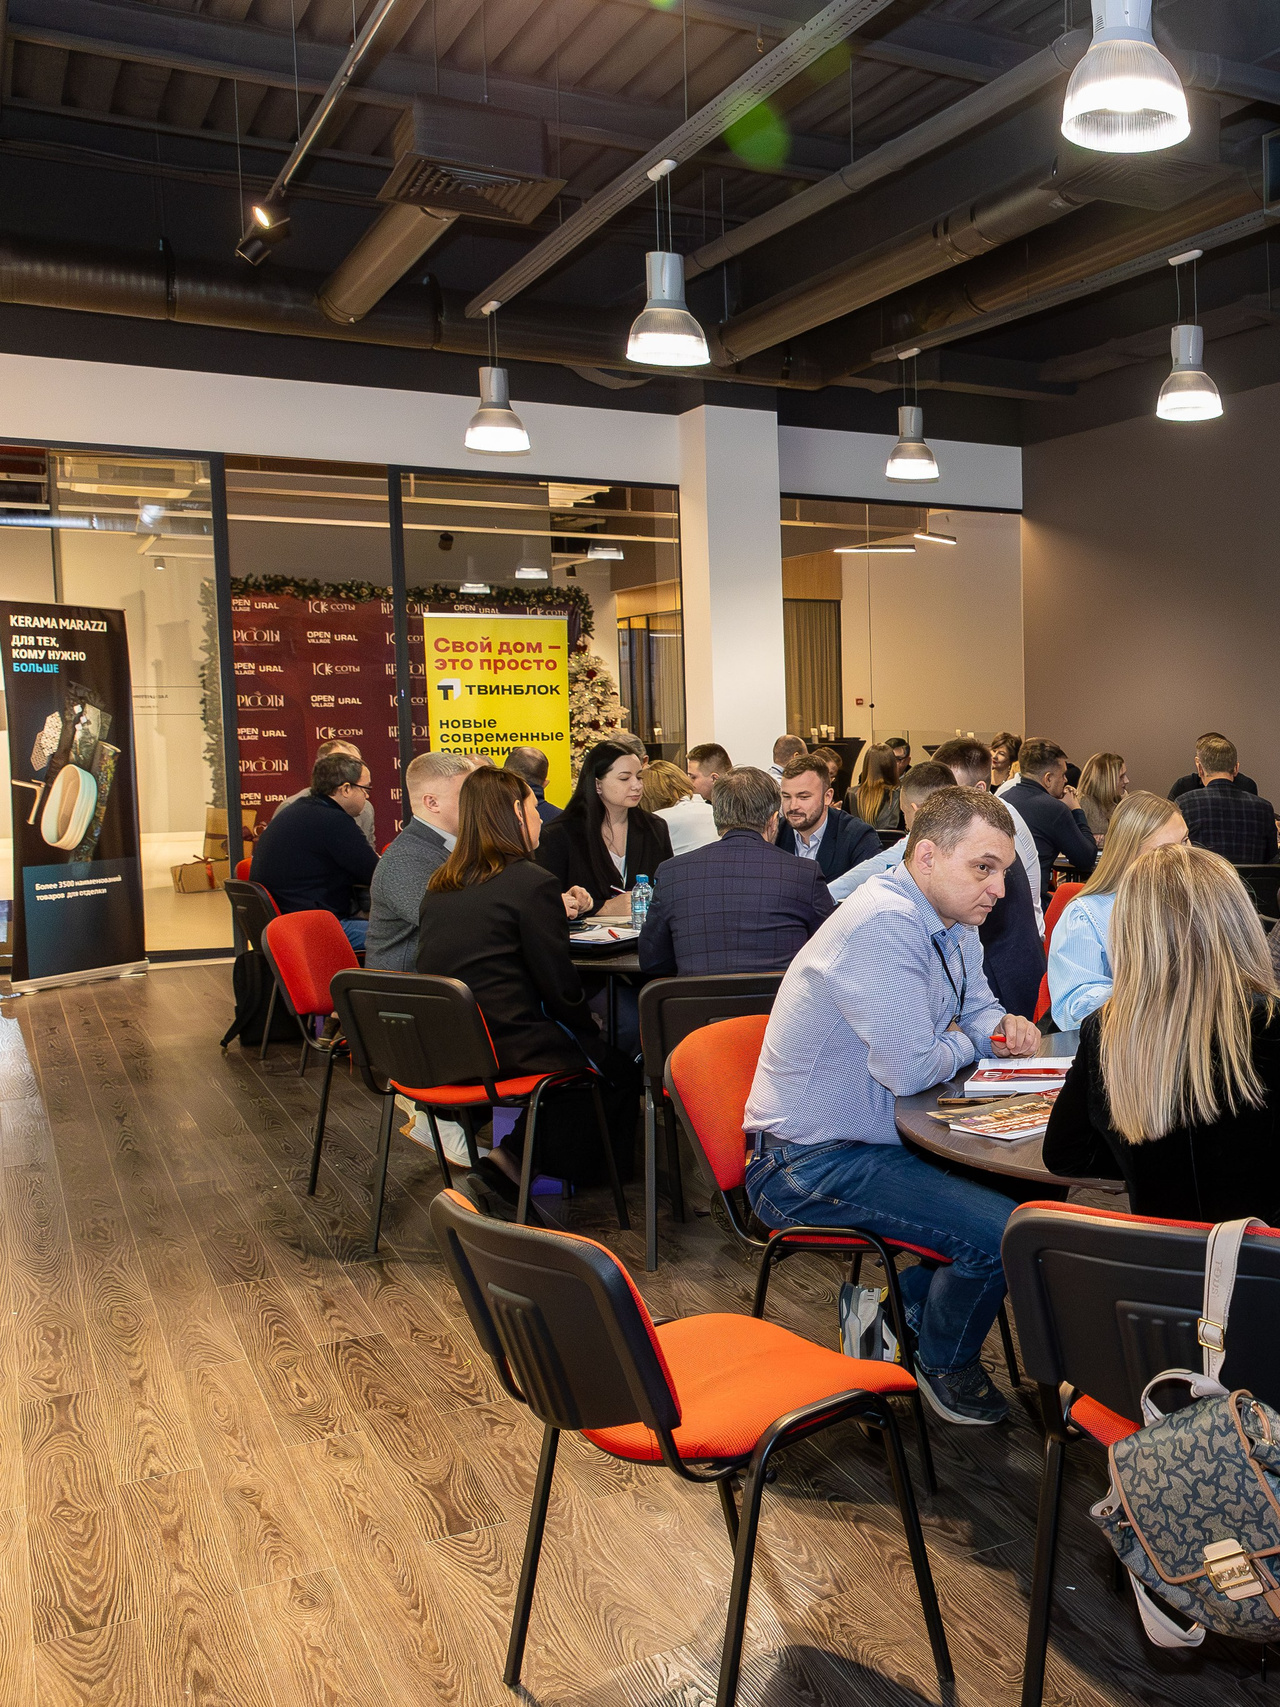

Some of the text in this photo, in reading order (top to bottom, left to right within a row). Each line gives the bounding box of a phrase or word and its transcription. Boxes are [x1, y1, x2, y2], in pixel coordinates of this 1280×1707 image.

[454, 604, 476, 612] OPEN
[9, 615, 107, 632] KERAMA MARAZZI
[11, 635, 59, 648] ДЛЯ ТЕХ,
[434, 637, 493, 653] Свой
[498, 641, 543, 655] дом
[12, 649, 86, 661] КОМУ НУЖНО
[13, 662, 59, 673] БОЛЬШЕ
[434, 658, 558, 674] это просто
[465, 684, 561, 696] ТВИНБЛОК
[439, 718, 497, 729] новые
[440, 731, 564, 745] современные
[35, 883, 58, 891] Более
[58, 880, 74, 889] 3500
[36, 892, 65, 901] товаров
